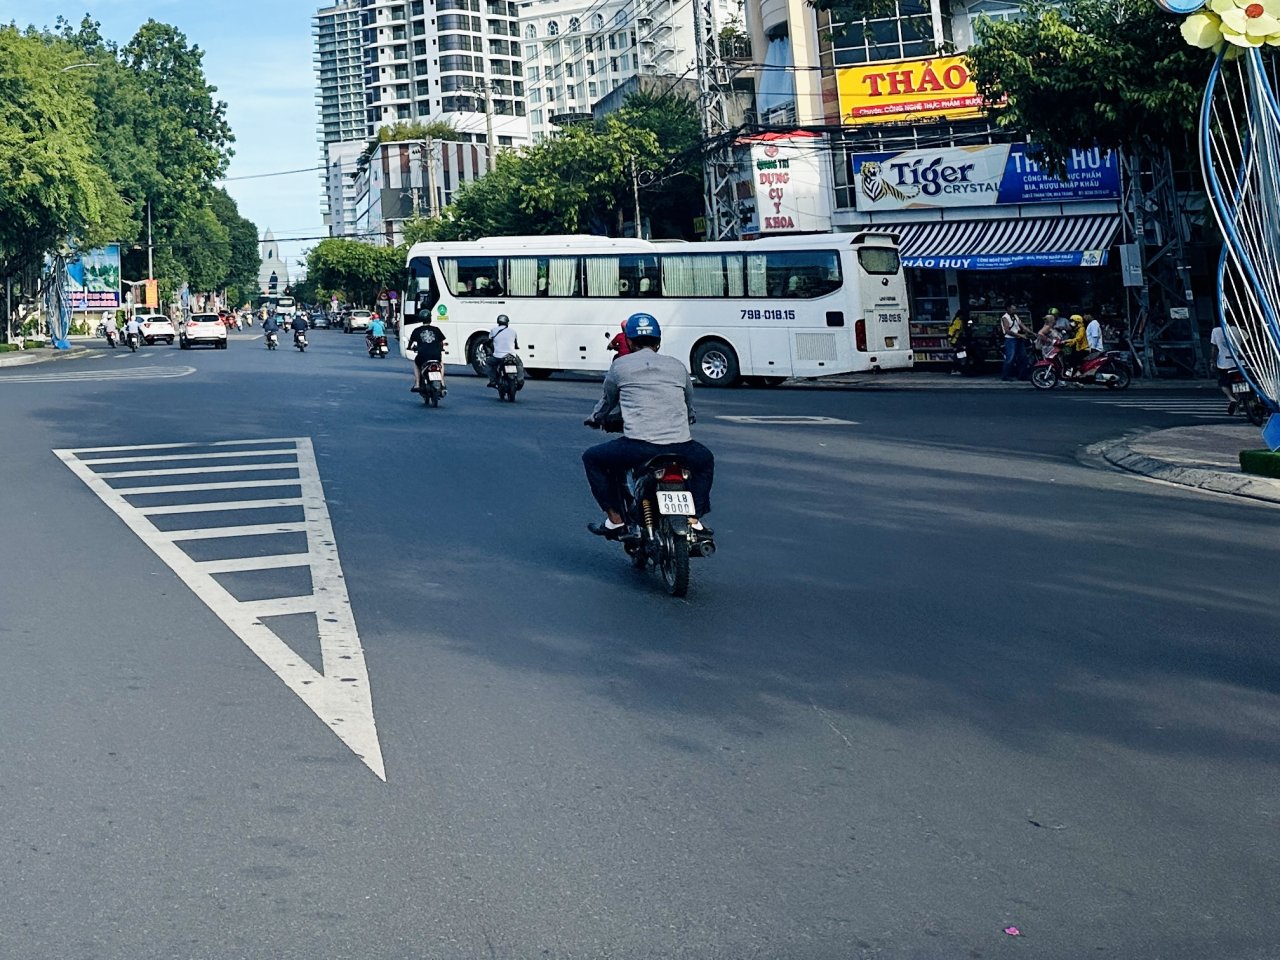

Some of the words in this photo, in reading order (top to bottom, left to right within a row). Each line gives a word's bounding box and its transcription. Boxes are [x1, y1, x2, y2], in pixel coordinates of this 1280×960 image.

[862, 60, 968, 97] THẢO
[759, 172, 790, 187] DỤNG
[890, 156, 975, 196] Tiger
[943, 182, 1002, 194] CRYSTAL
[773, 202, 782, 214] Y
[764, 215, 795, 229] KHOA
[901, 257, 935, 267] HẢO
[939, 258, 971, 269] HUY
[740, 309, 796, 320] 79B-018.15
[664, 503, 690, 513] 9000
